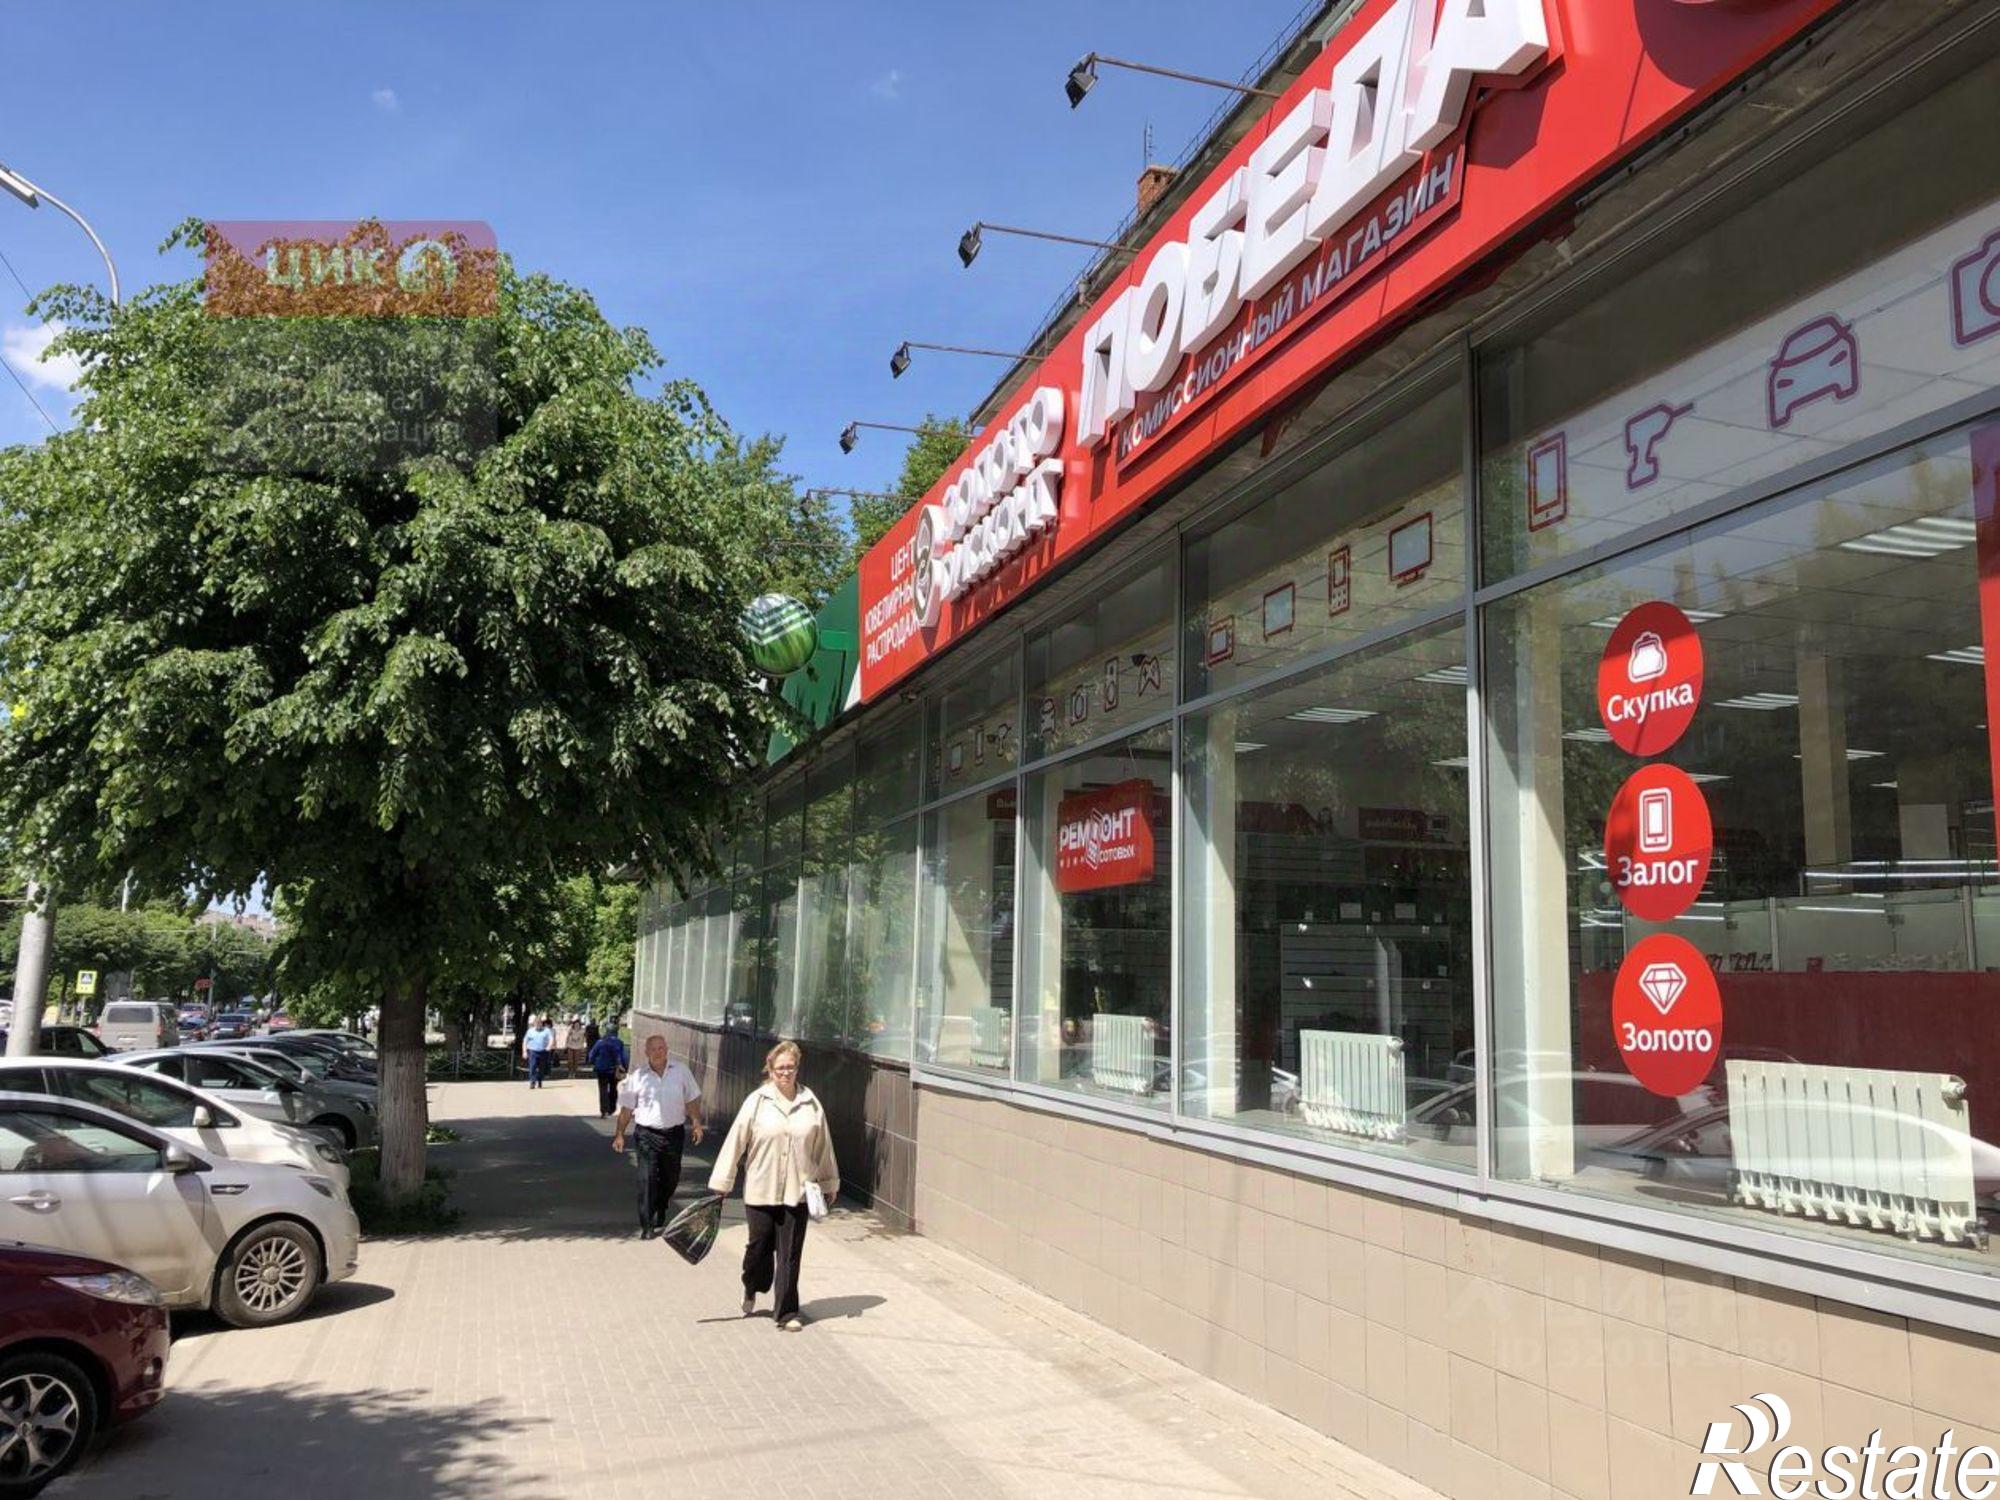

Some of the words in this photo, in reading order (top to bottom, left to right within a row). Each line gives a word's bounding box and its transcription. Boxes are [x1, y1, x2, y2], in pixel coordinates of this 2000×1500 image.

[1077, 0, 1548, 448] ПОБЕДА
[1120, 281, 1296, 457] КОМИССИОННЫЙ
[1300, 154, 1454, 310] МАГАЗИН
[891, 535, 917, 582] ЦЕНТ
[864, 572, 915, 635] ЮВЕЛИРНЫ
[1606, 682, 1695, 725] Скупка
[1059, 807, 1136, 852] РЕМОНТ
[1617, 855, 1700, 888] Залог
[1621, 1022, 1713, 1055] Золото
